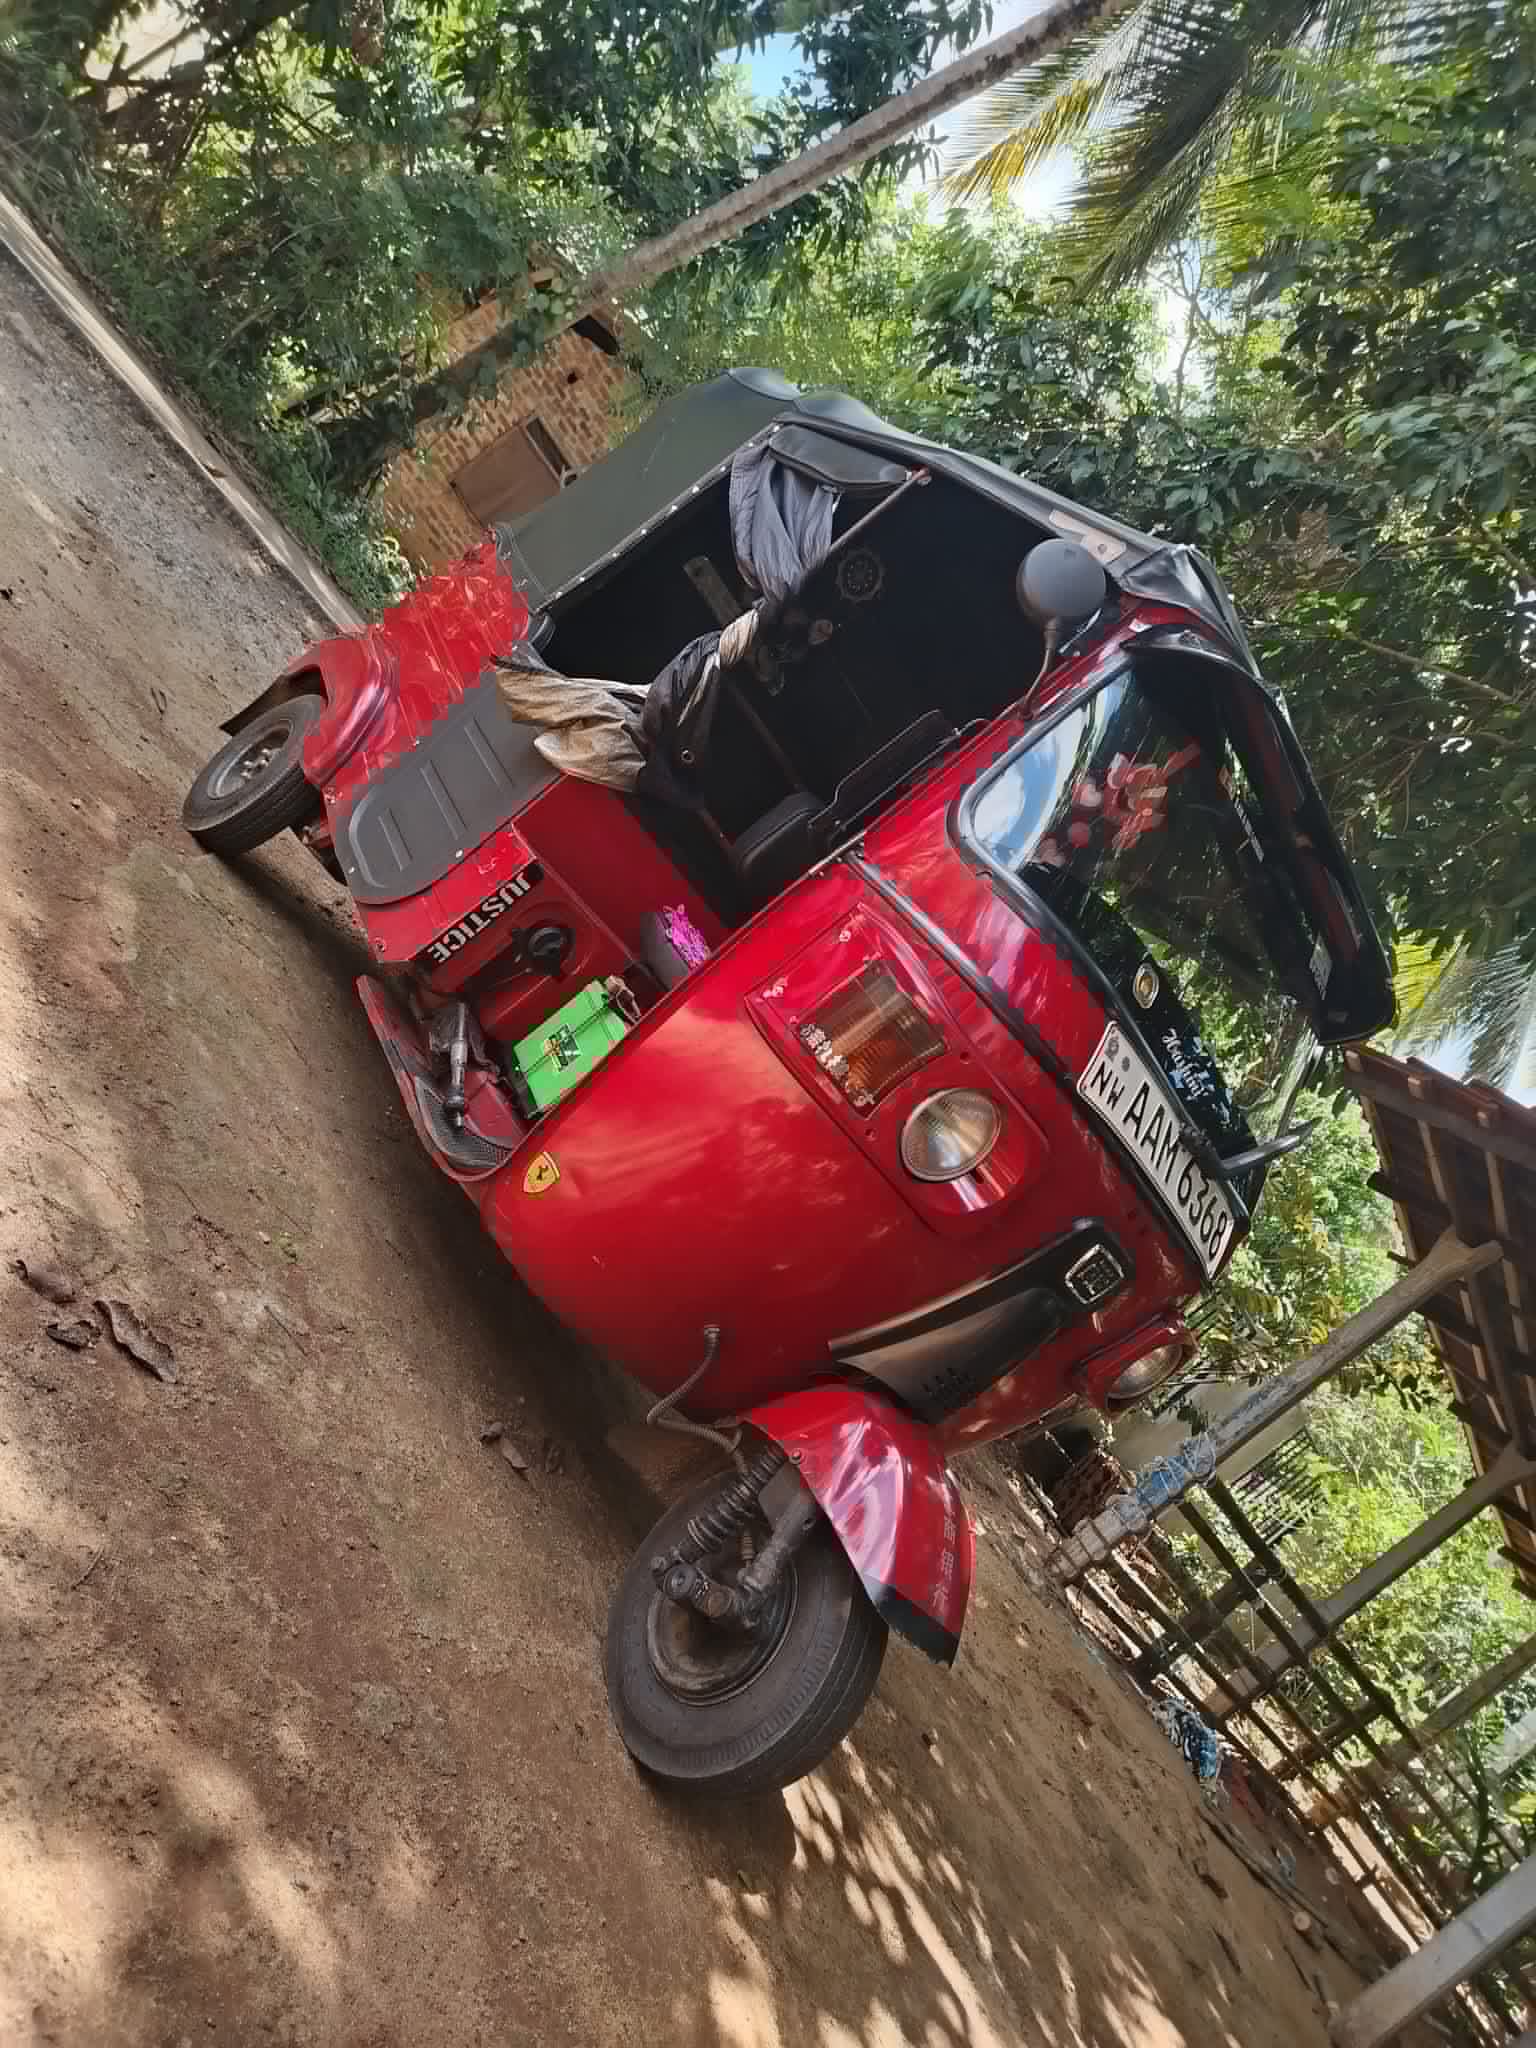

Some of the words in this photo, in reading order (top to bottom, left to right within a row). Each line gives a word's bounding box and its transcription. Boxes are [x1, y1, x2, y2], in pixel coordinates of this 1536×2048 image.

[427, 872, 531, 963] JUSTICE
[1090, 1061, 1125, 1111] NW
[1123, 1081, 1180, 1184] AAM
[1177, 1156, 1229, 1258] 6368
